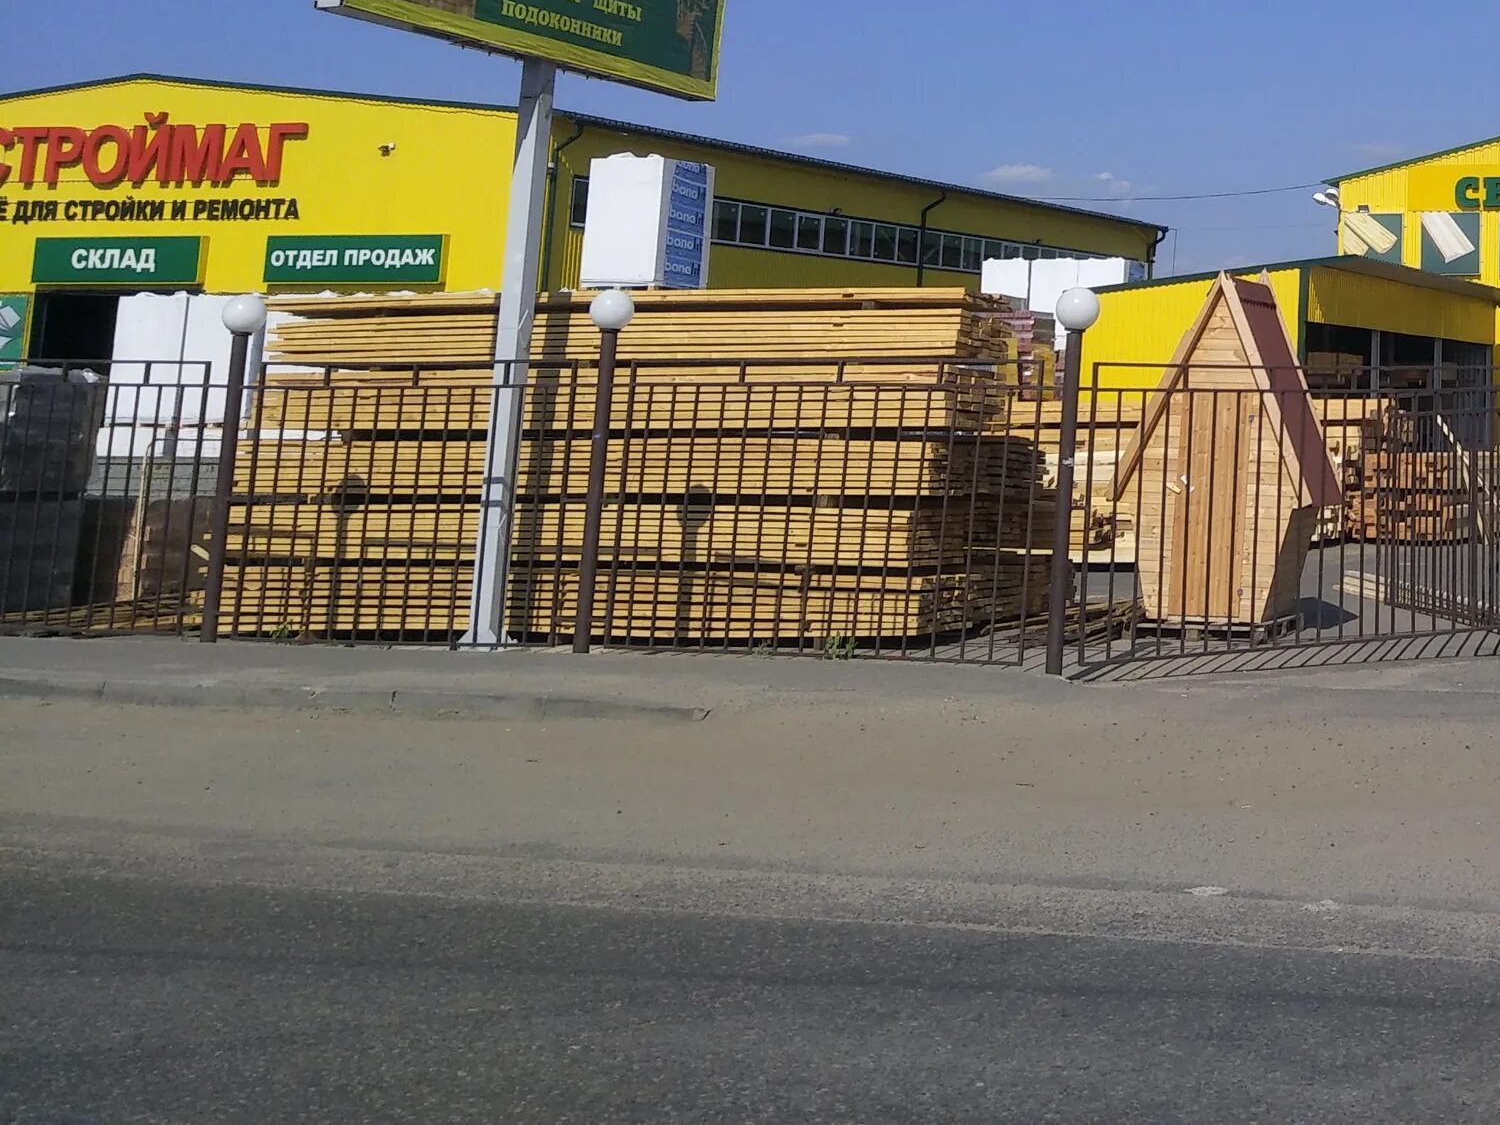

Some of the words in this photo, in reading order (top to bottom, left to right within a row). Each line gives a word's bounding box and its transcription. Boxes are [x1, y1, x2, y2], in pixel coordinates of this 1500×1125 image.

[500, 0, 624, 47] ПОДОКОННИКИ
[12, 200, 58, 225] ДЛЯ
[64, 195, 165, 221] СТРОЙКИ
[171, 199, 185, 220] И
[193, 198, 300, 221] РЕМОНТА
[71, 248, 156, 273] СКЛАД
[271, 249, 339, 269] ОТДЕЛ
[344, 248, 435, 269] ПРОДАЖ
